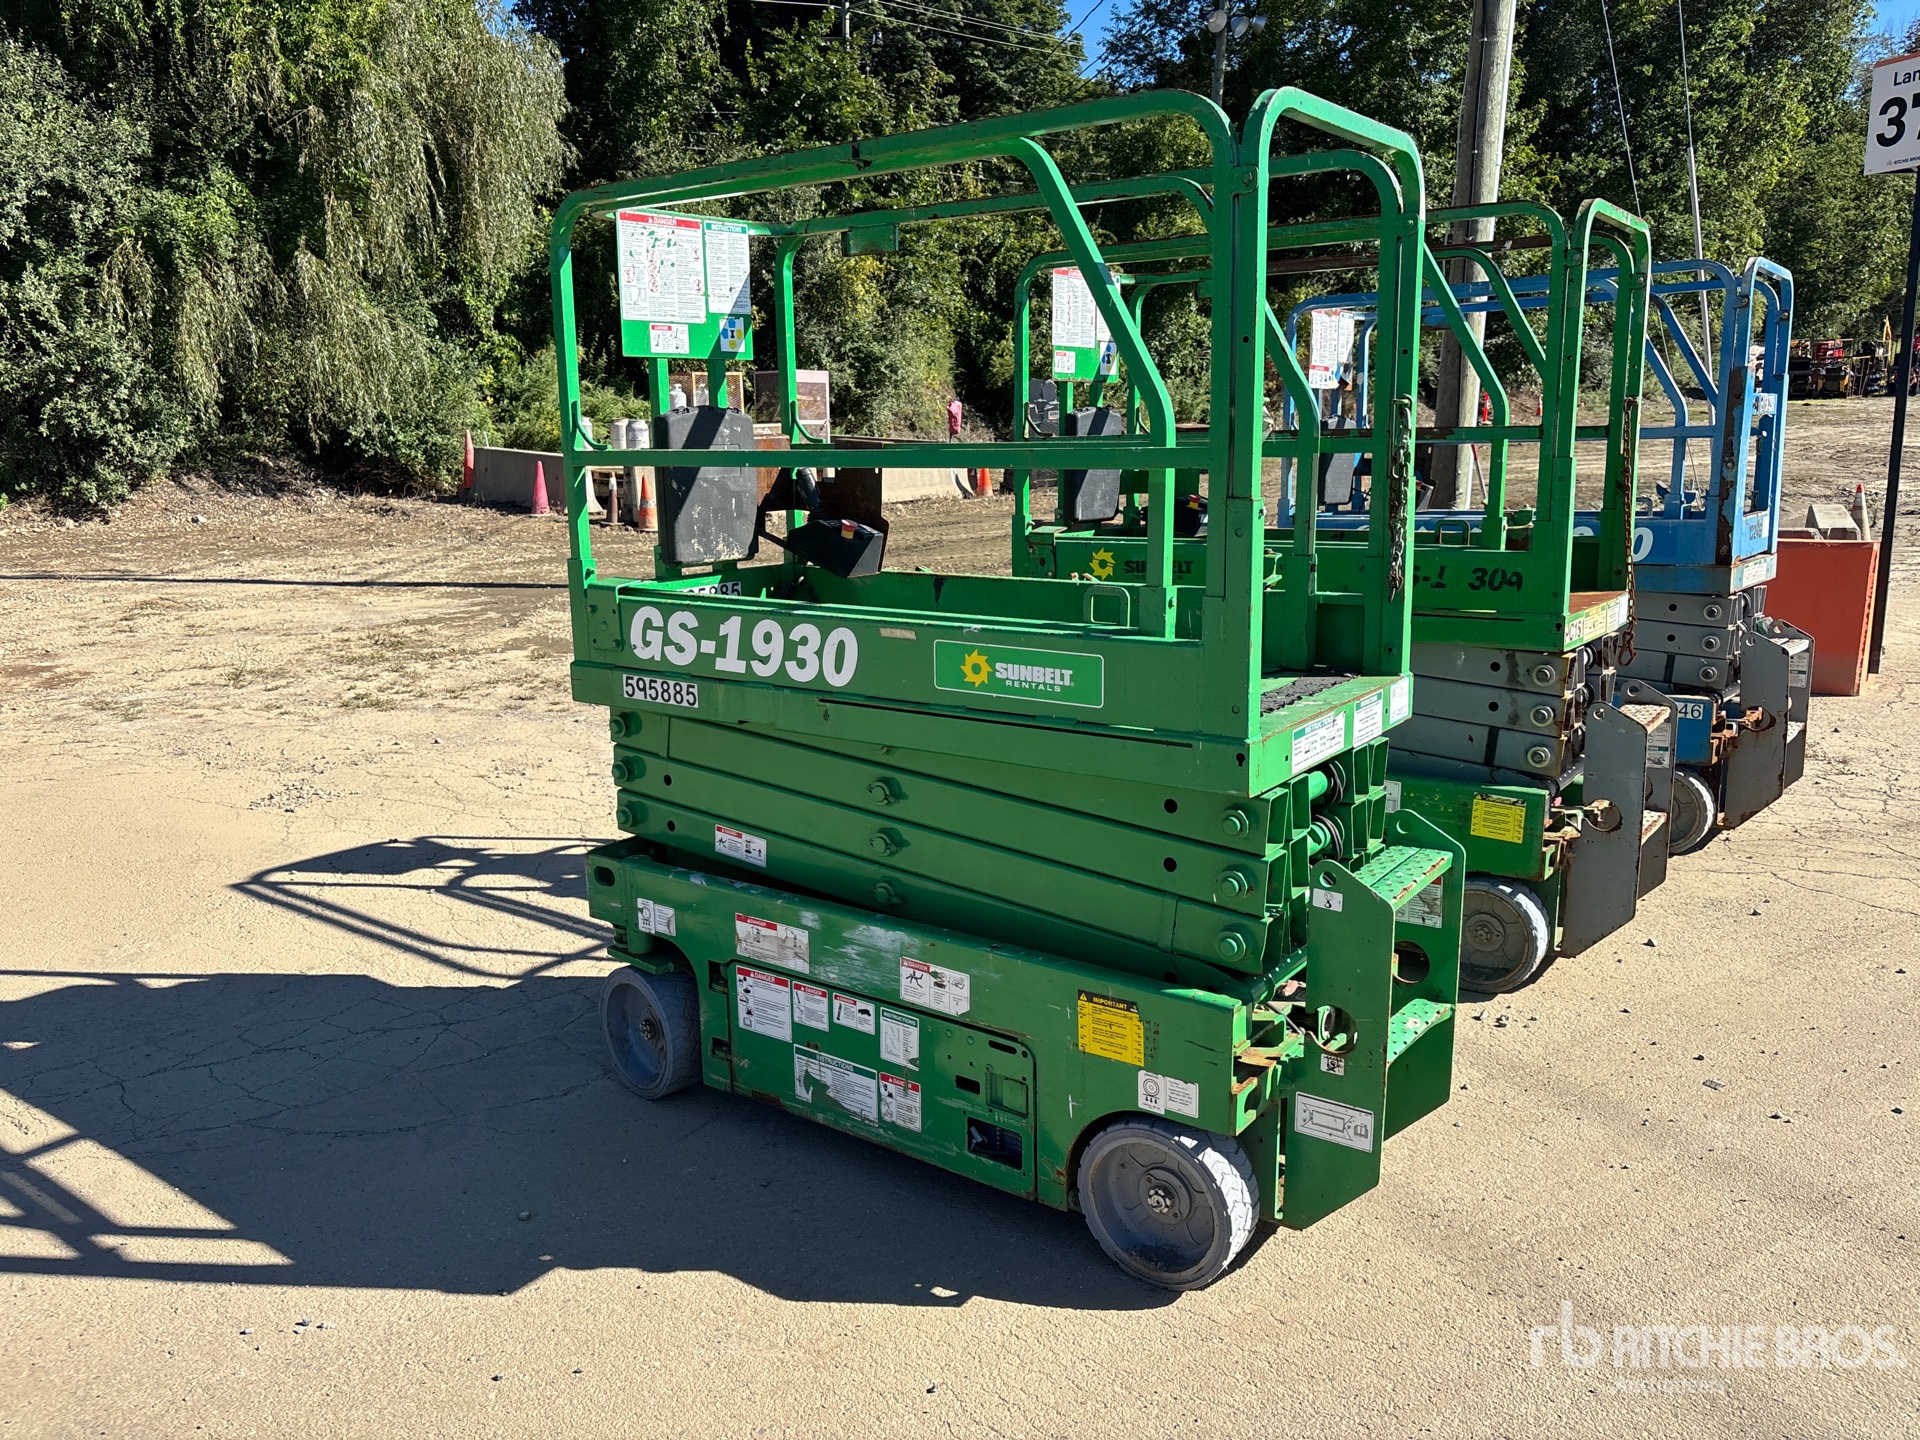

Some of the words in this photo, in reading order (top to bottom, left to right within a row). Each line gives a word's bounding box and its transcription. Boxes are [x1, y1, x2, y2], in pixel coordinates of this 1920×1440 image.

[654, 216, 677, 226] DANGER
[630, 606, 858, 687] GS-1930
[995, 662, 1073, 686] SUNBELT
[624, 676, 697, 707] 595885
[1005, 680, 1062, 693] RENTALS
[907, 961, 928, 971] DANGER
[755, 971, 775, 983] DANGER
[805, 986, 822, 996] DANGER
[1092, 996, 1127, 1010] IMPORTANT
[883, 1011, 916, 1026] INSTRUCTIONS
